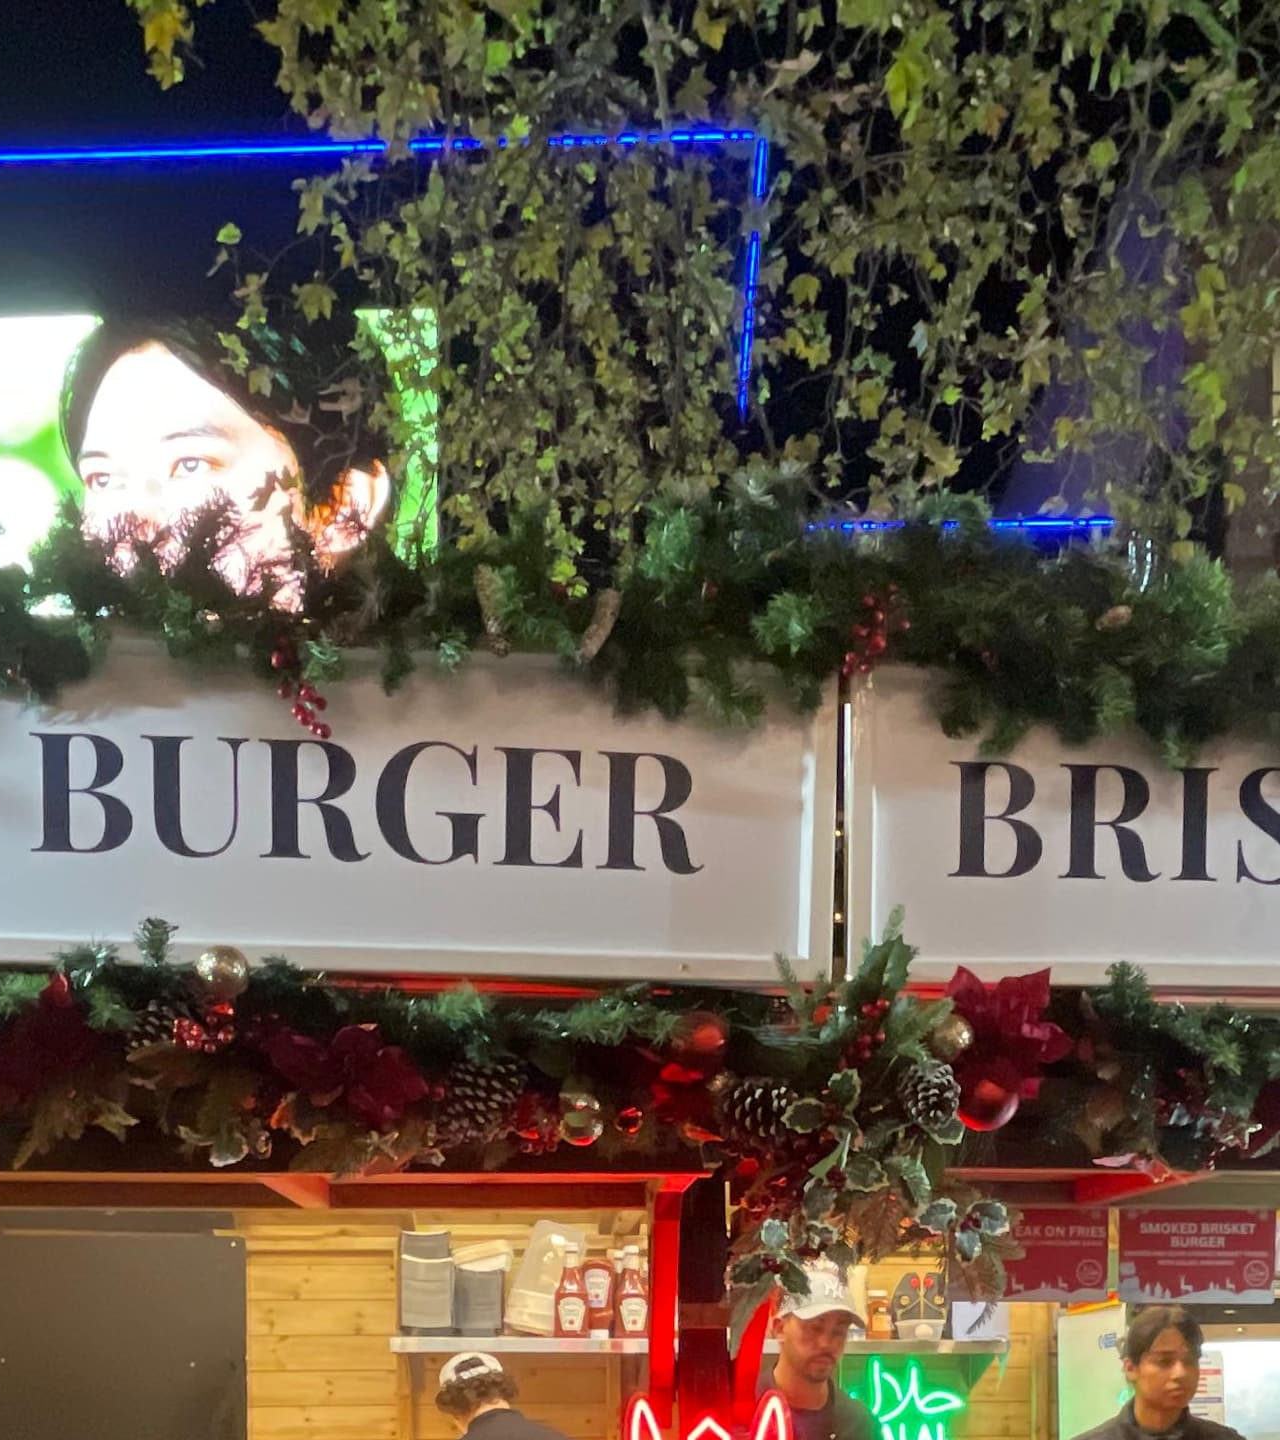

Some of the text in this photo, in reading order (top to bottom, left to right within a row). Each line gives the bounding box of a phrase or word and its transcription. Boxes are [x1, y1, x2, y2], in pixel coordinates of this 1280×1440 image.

[28, 730, 706, 876] BURGER
[1012, 1225, 1107, 1239] EAK ON FRIES
[1139, 1222, 1257, 1235] SMOKED BRISKET
[1170, 1236, 1226, 1249] BURGER
